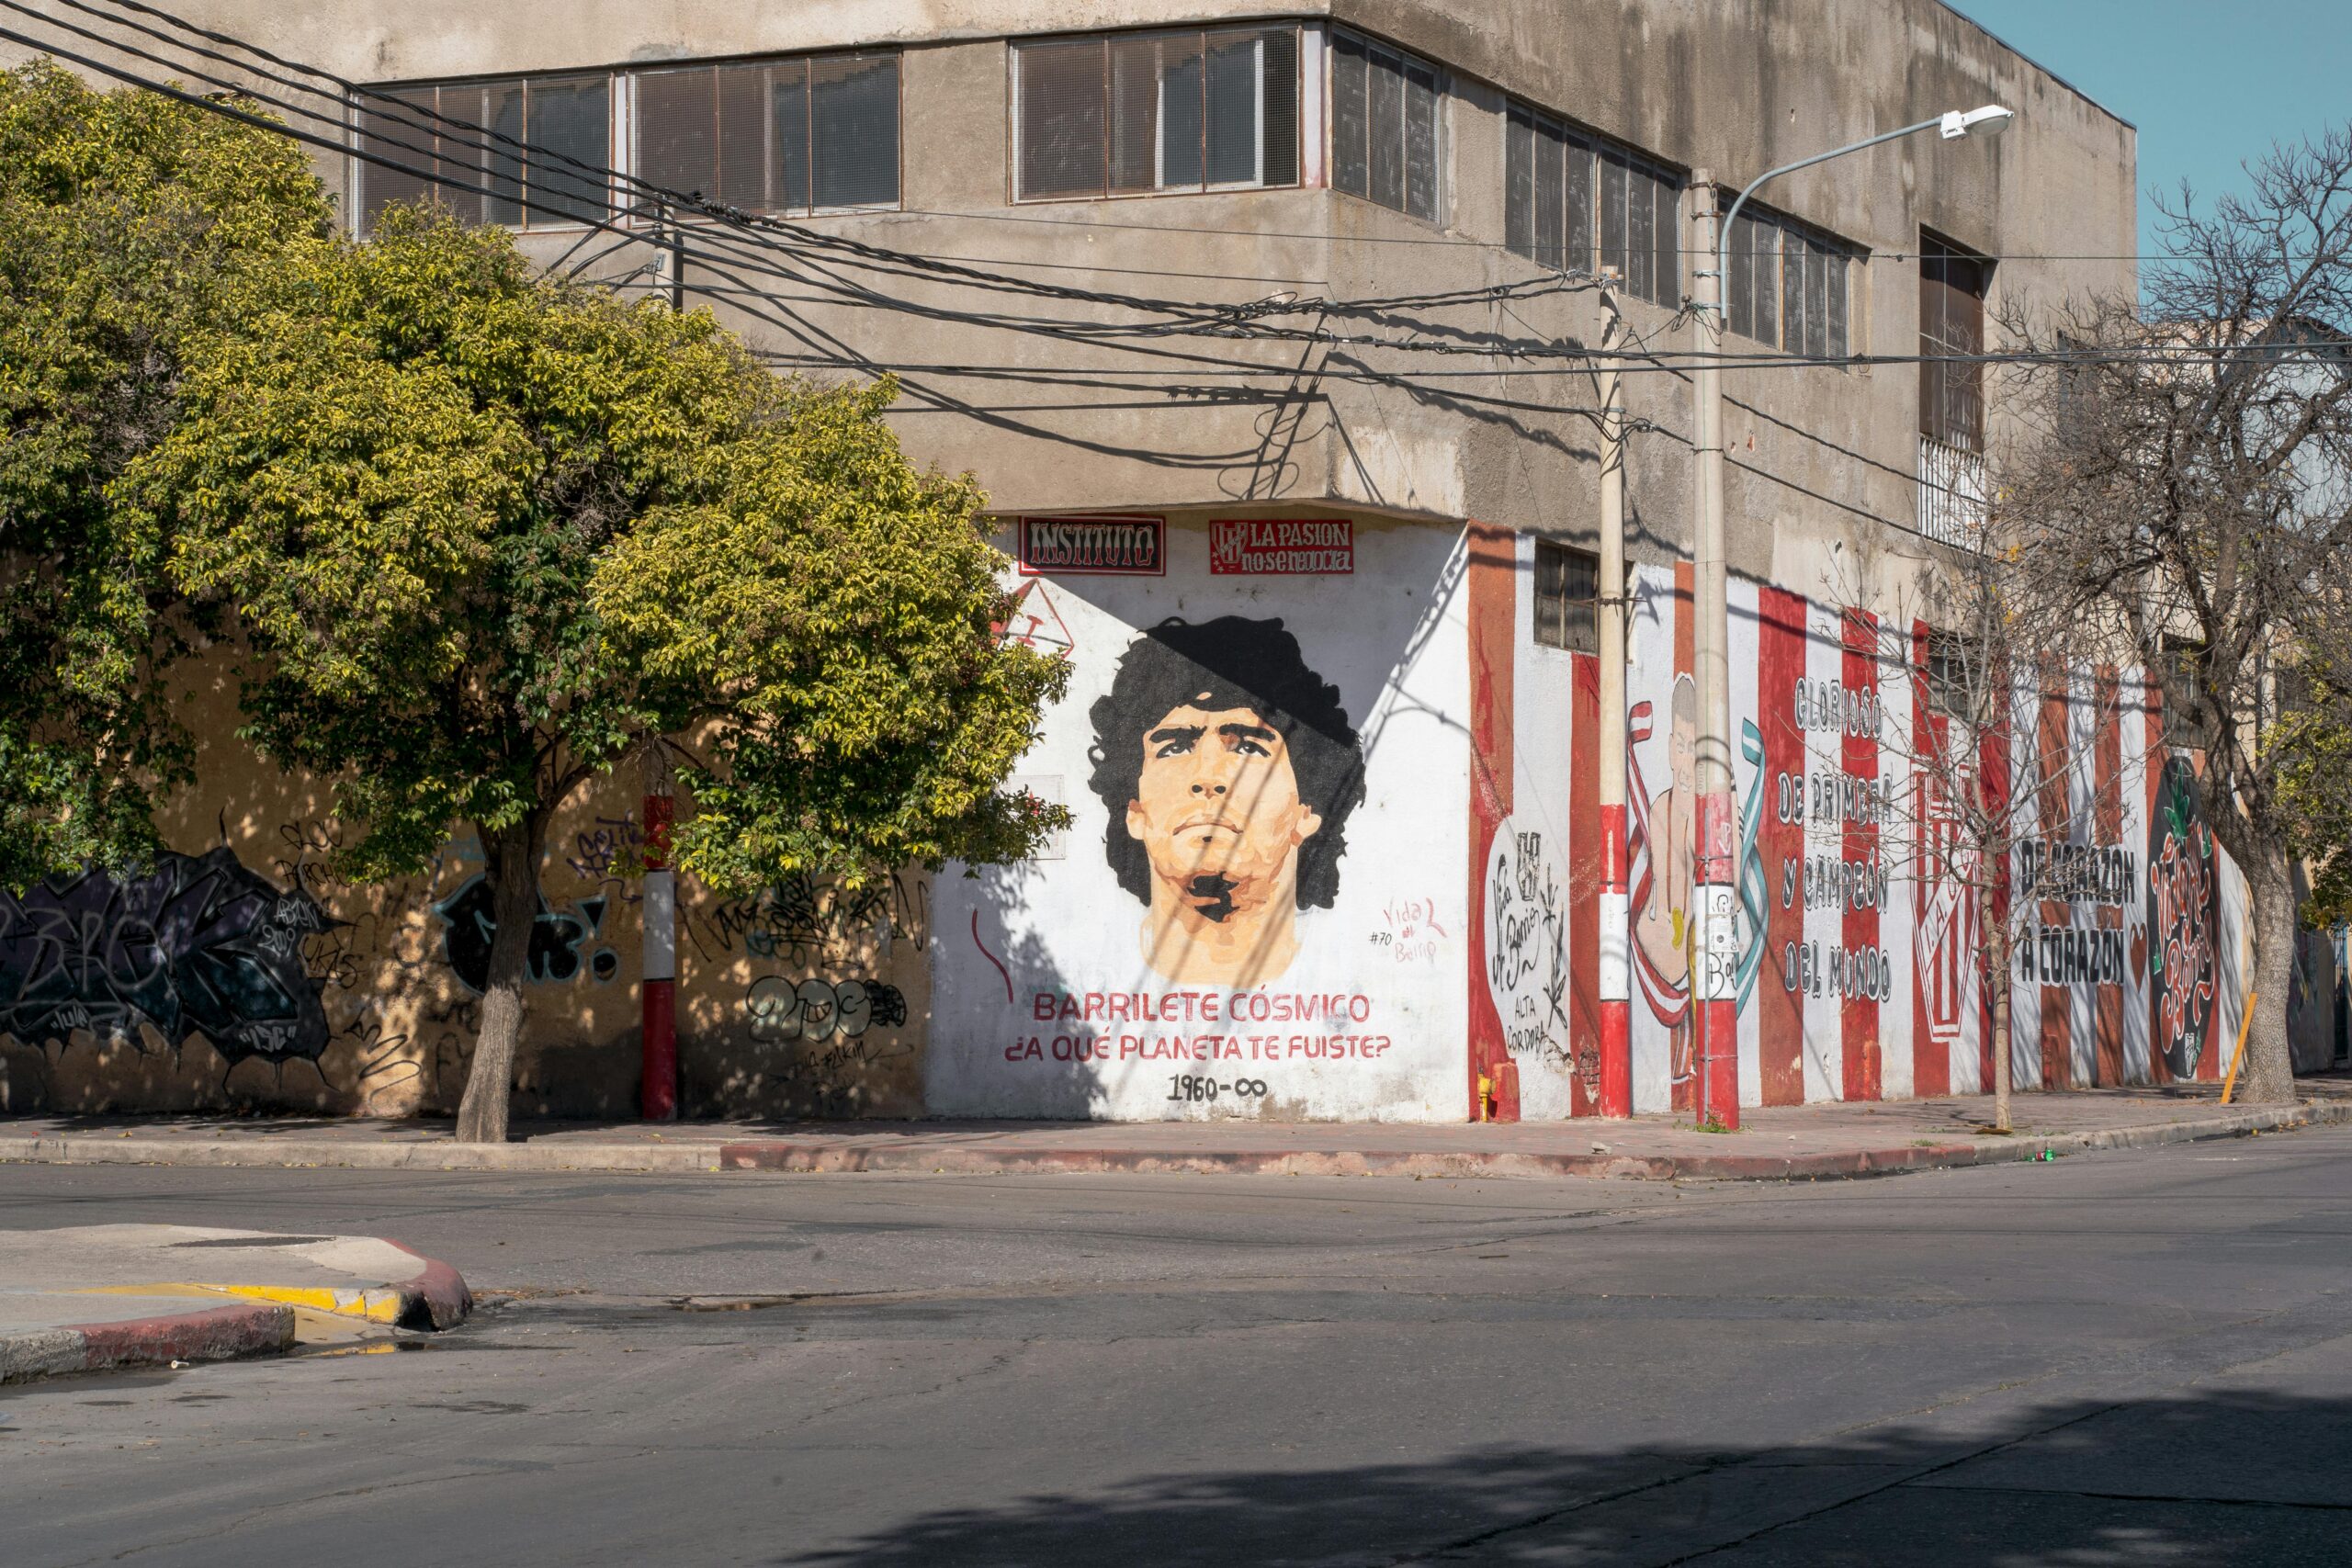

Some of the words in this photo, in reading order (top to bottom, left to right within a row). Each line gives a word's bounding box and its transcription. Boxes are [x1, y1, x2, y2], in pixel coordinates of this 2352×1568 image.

[1030, 522, 1155, 567] INSTITUTO
[1250, 523, 1277, 547] LA
[1277, 523, 1351, 547] PASION
[1794, 676, 1883, 739] GLORIOSO
[1778, 770, 1804, 825] DE
[1810, 772, 1894, 829] PRIMERA
[1781, 855, 1797, 909] Y
[1784, 940, 1822, 999] DEL
[1827, 942, 1893, 1004] MUNDO
[1034, 992, 1219, 1023] BARRILETE
[1229, 984, 1370, 1023] CÓSMICO
[1514, 994, 1536, 1021] ALTA
[1004, 1036, 1045, 1062] ¿A
[1052, 1026, 1111, 1062] QUÉ
[1120, 1034, 1243, 1061] PLANETA
[1248, 1035, 1280, 1061] TE
[1288, 1035, 1392, 1059] FUISTE?
